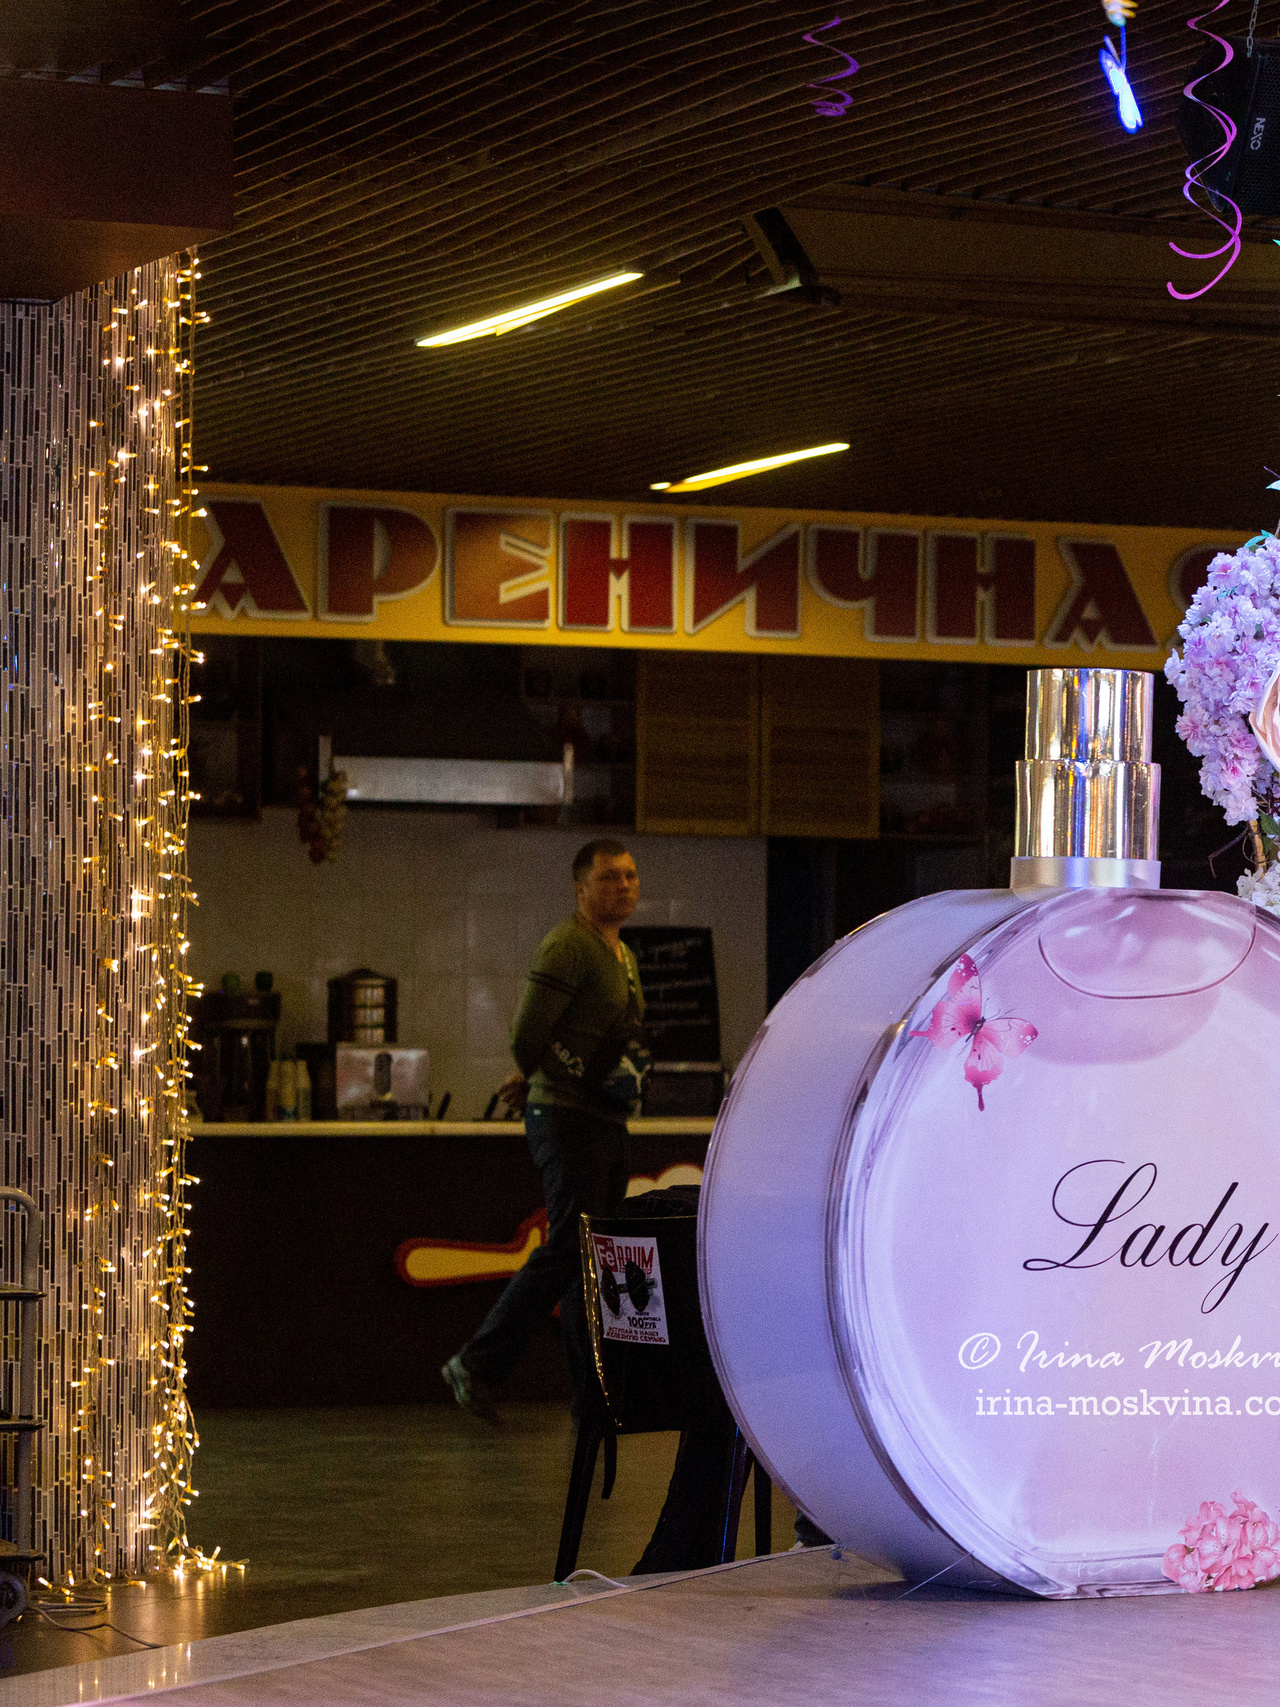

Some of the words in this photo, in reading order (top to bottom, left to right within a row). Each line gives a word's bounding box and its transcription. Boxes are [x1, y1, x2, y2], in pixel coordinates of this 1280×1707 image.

[1250, 117, 1266, 150] NEXO
[1022, 1159, 1279, 1314] Lady
[628, 1317, 644, 1328] 100
